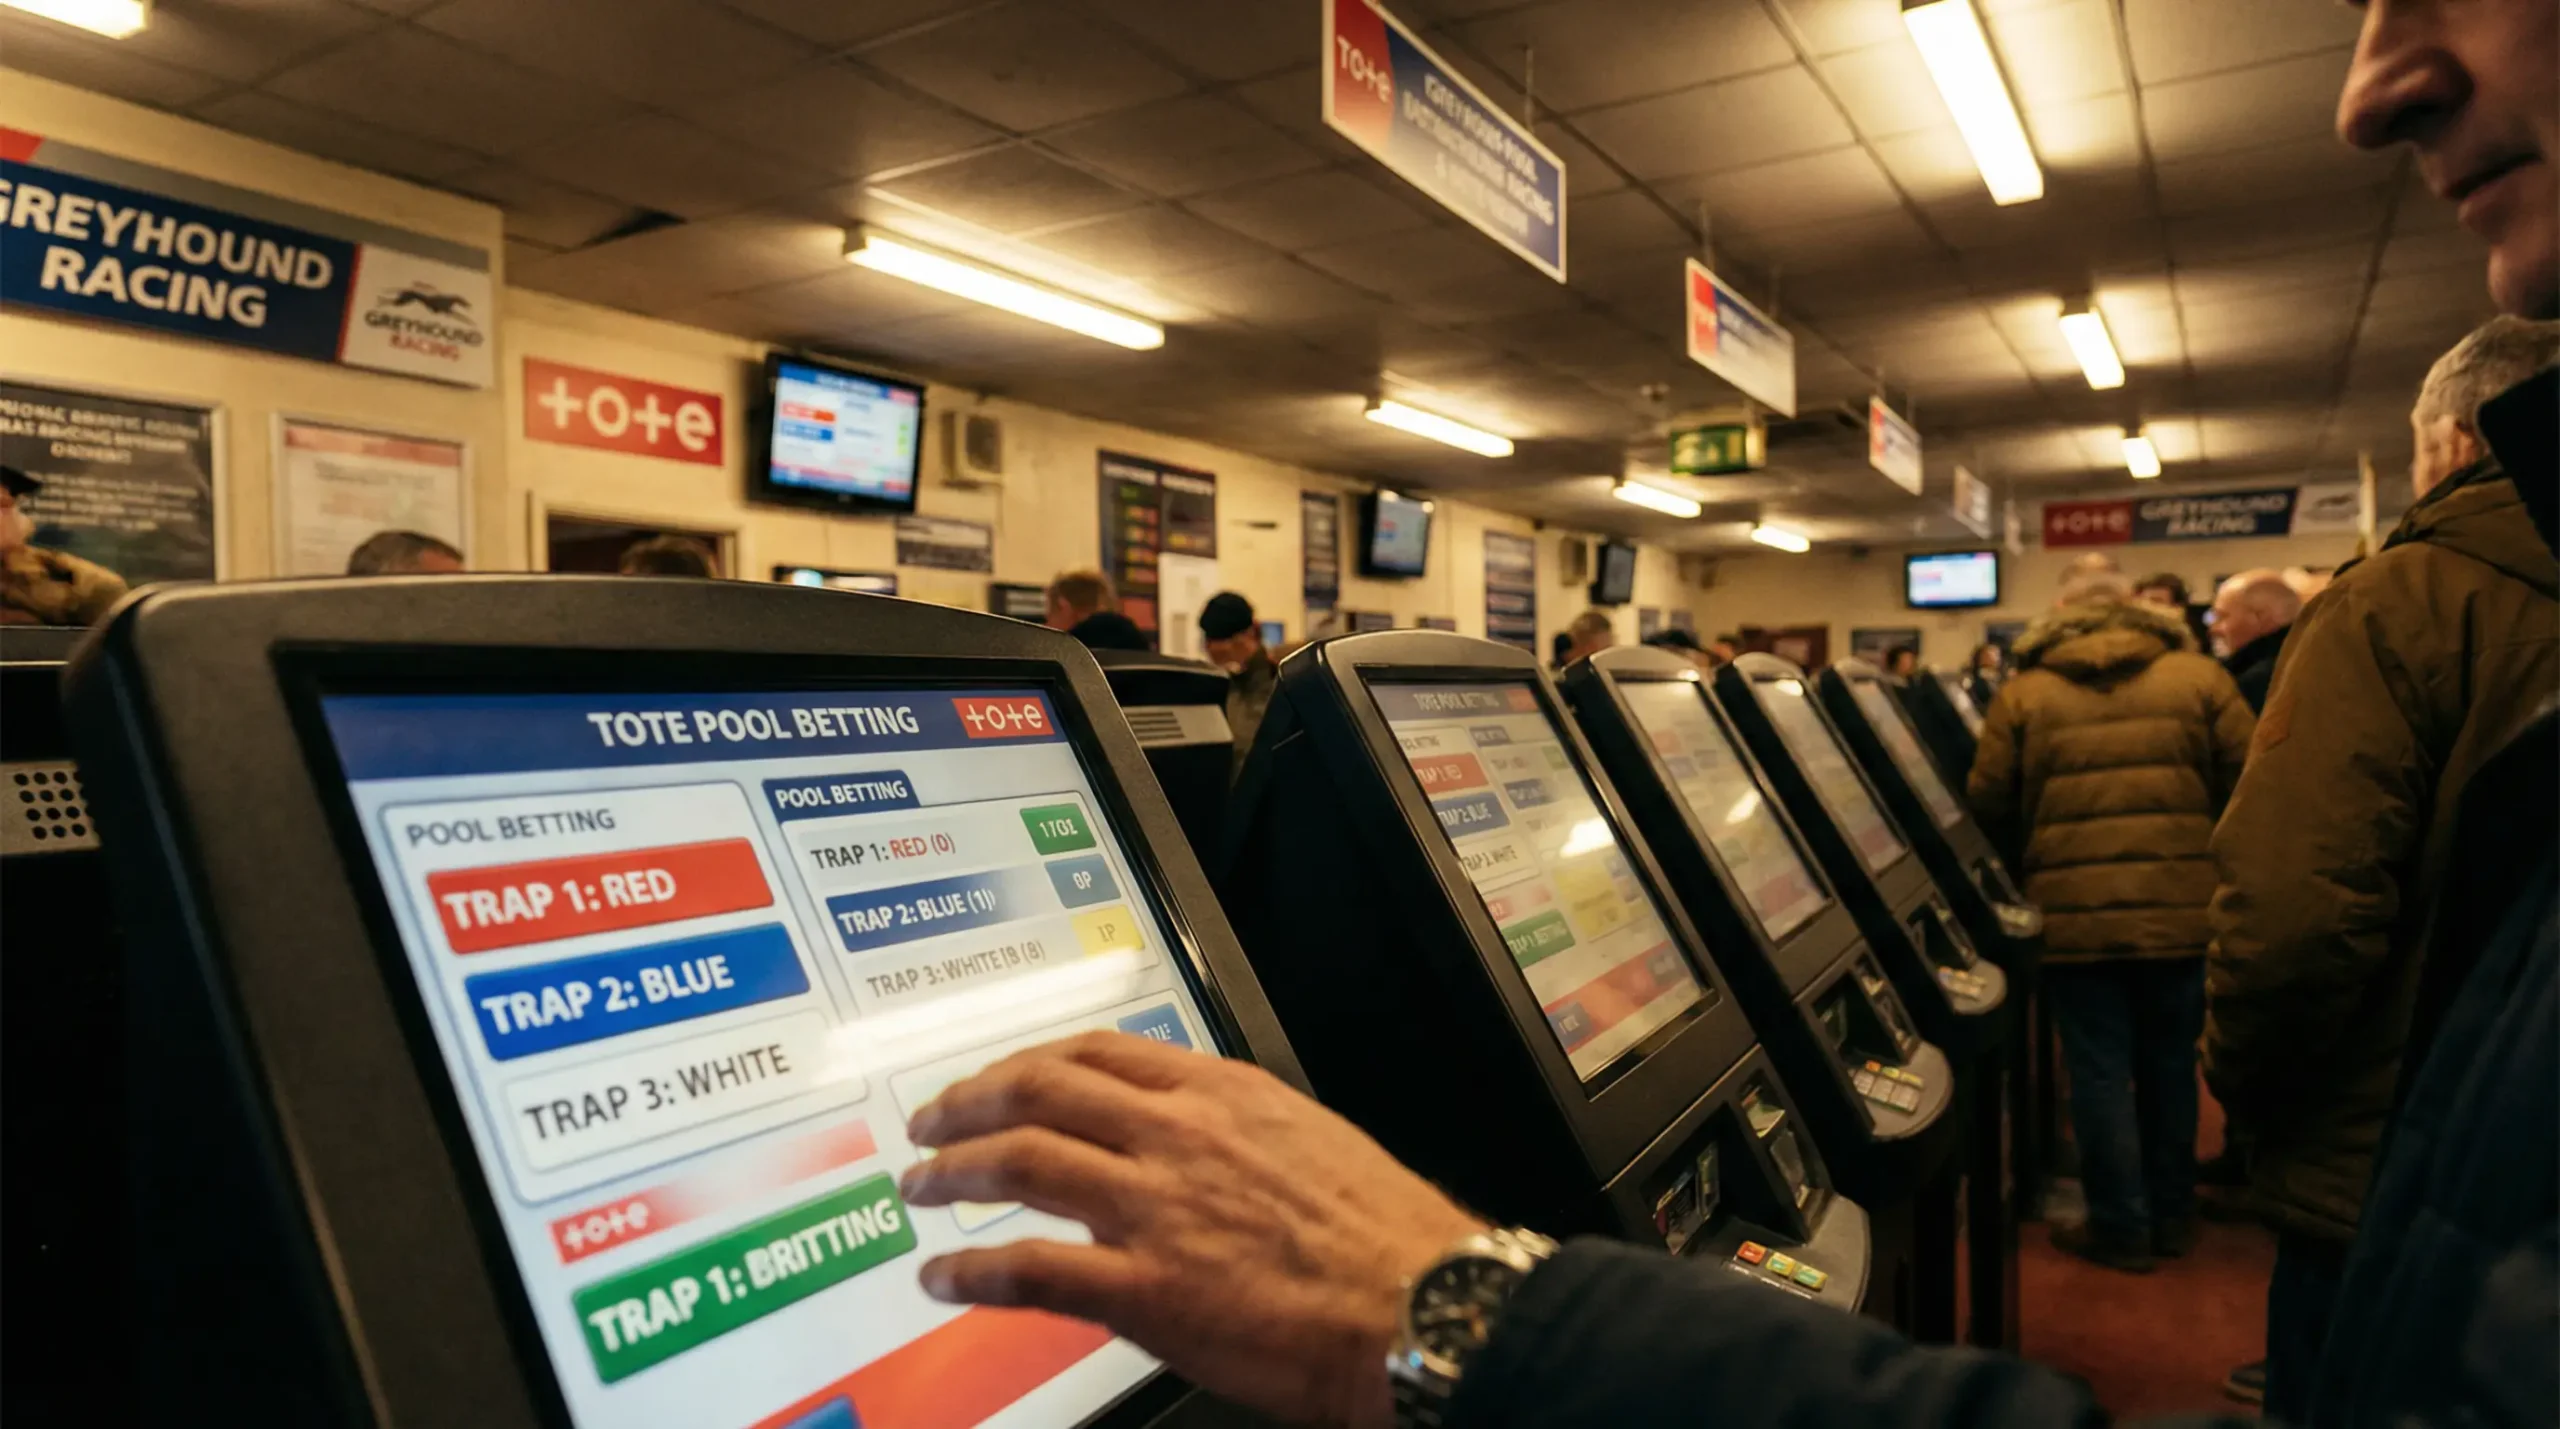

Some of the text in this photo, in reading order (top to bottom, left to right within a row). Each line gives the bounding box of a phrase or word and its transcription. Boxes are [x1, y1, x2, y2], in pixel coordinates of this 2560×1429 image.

[40, 245, 268, 328] RACING
[364, 308, 485, 348] GREYHOUND
[587, 704, 919, 748] TOTE POOL BETTING
[774, 778, 908, 809] POOL BETTING
[406, 808, 617, 848] POOL BETTING
[811, 832, 957, 870] TRAP 1: RED (0)
[442, 868, 677, 930] TRAP 1: RED
[836, 904, 894, 935] TRAP
[895, 902, 920, 926] 2:
[915, 892, 968, 921] BLUE
[480, 955, 735, 1035] TRAP 2: BLUE
[866, 967, 920, 999] TRAP
[922, 965, 945, 986] 3:
[941, 950, 1002, 980] WHITE
[523, 1043, 792, 1142] TRAP 3: WHITE
[587, 1277, 702, 1352] TRAP
[705, 1265, 748, 1306] 1:
